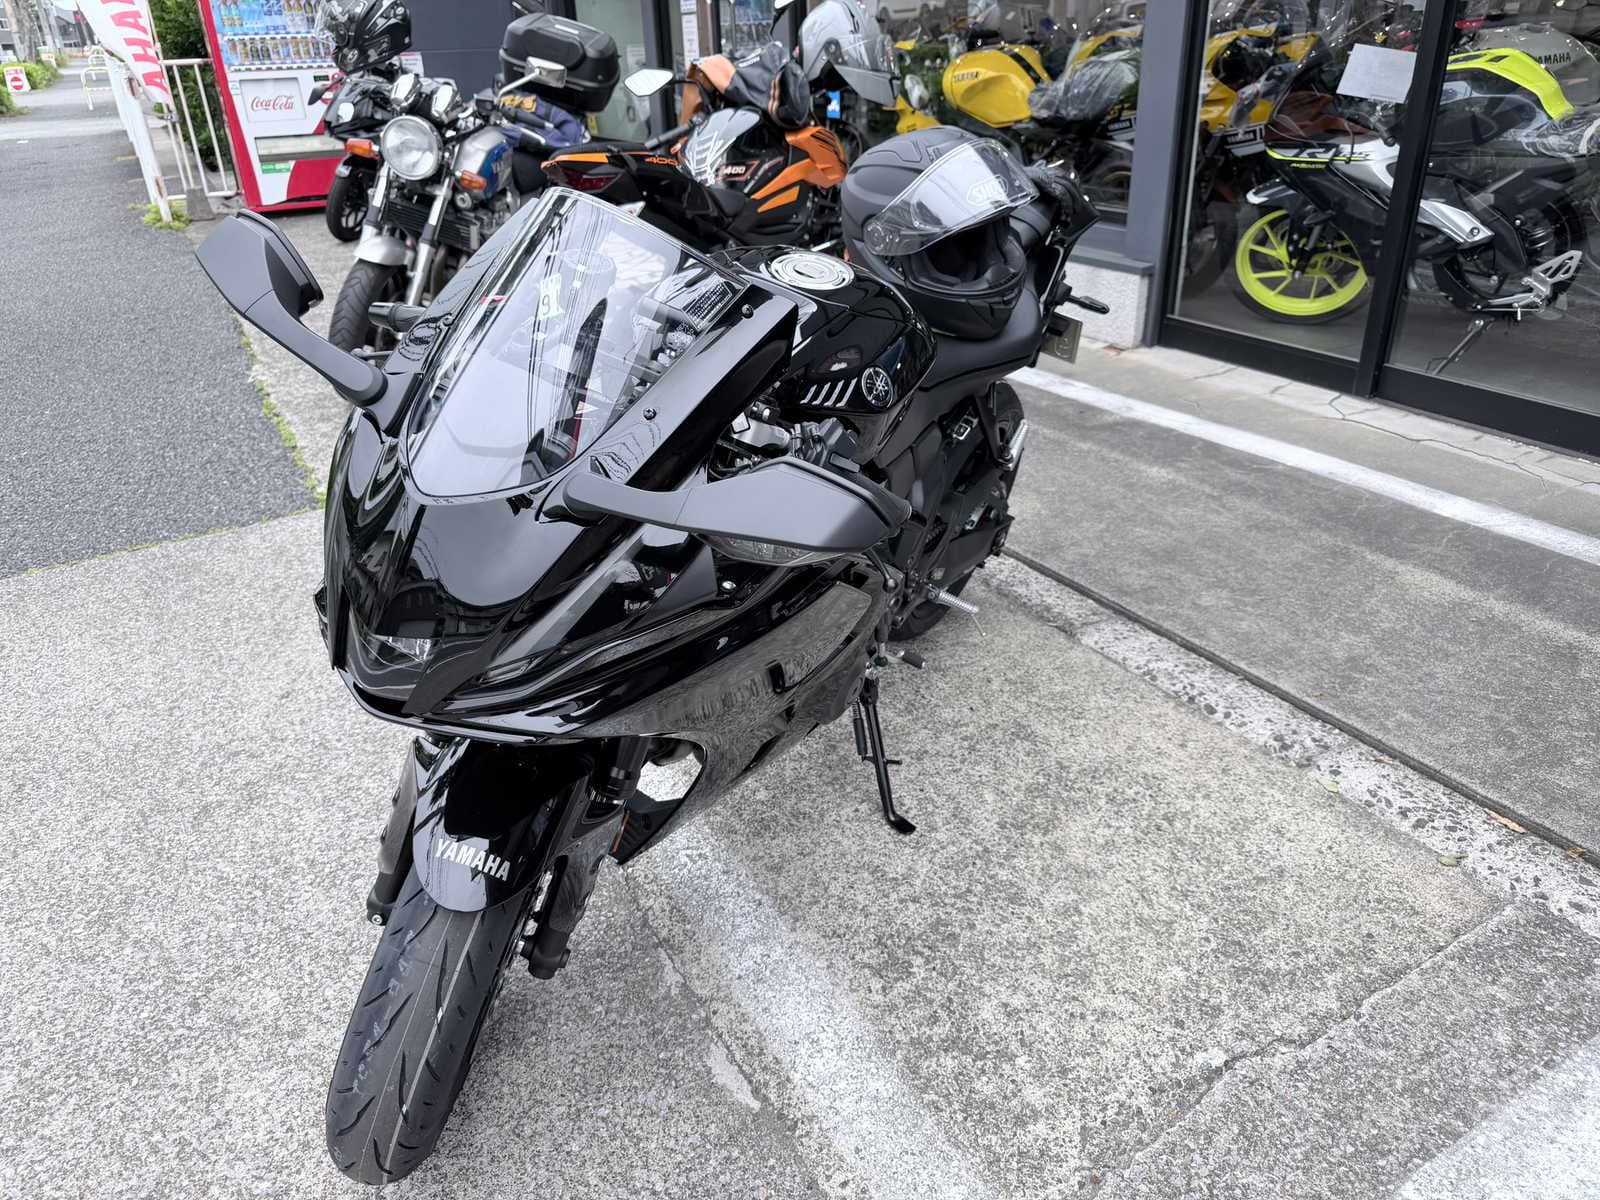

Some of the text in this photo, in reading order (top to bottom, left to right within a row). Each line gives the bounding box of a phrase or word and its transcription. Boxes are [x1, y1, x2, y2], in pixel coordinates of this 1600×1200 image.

[1535, 51, 1571, 64] AMAHA
[644, 156, 679, 166] 400
[435, 838, 511, 881] YAMAHA
